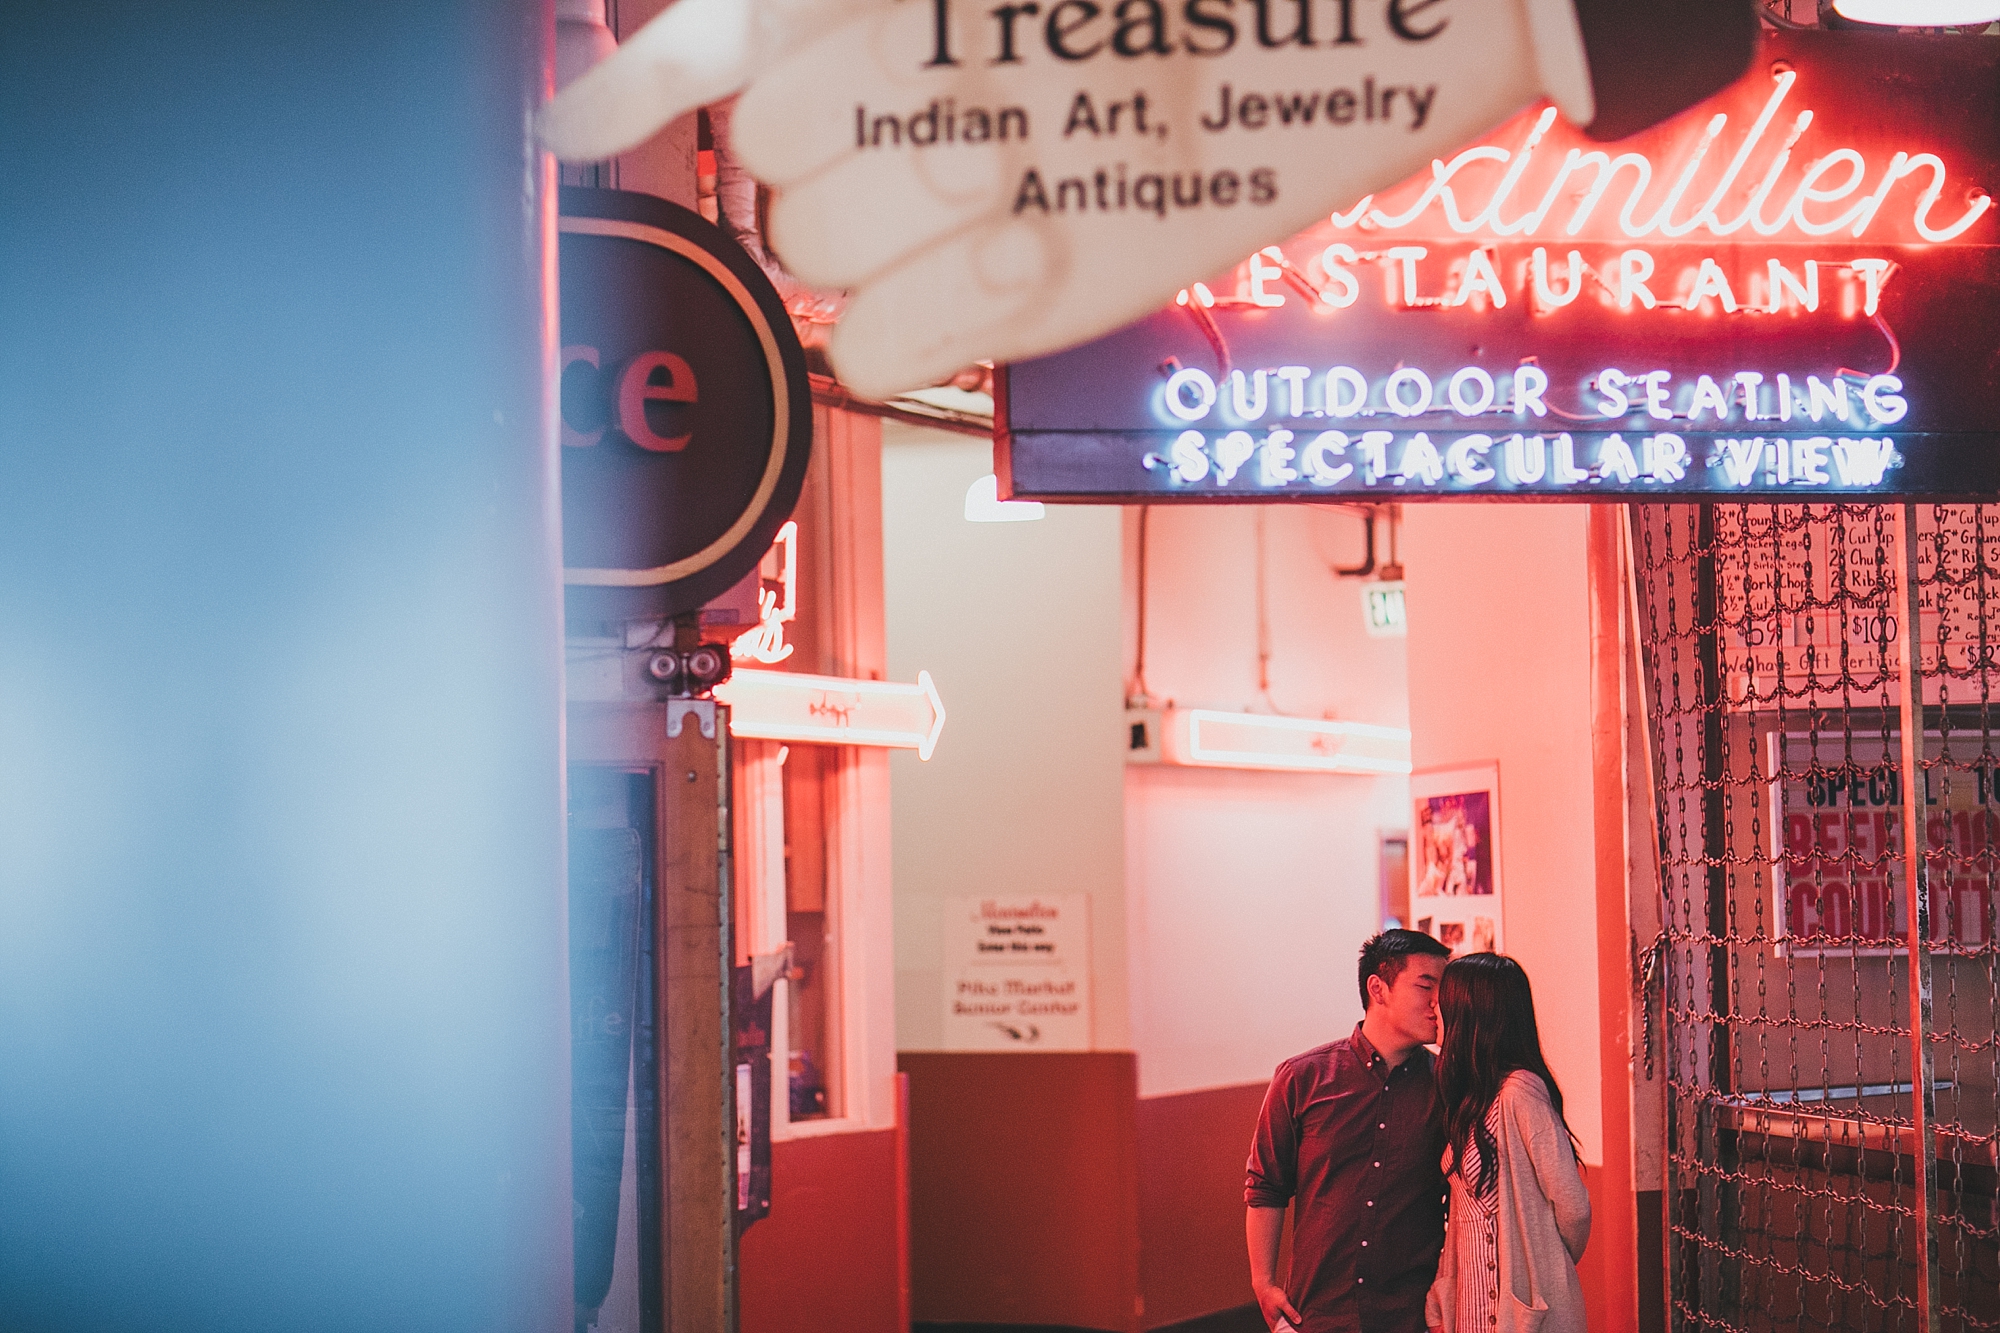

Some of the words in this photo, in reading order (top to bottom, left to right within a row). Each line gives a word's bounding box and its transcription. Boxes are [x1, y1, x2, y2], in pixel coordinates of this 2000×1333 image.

[855, 103, 1029, 148] Indian
[1062, 90, 1169, 138] Art,
[1202, 76, 1439, 132] Jewelry
[1011, 161, 1279, 219] Antiques
[1175, 244, 1889, 317] ESTAURANT
[1165, 365, 1549, 421] OUTDOOR
[1597, 367, 1908, 425] SEATING
[1168, 428, 1688, 484] SPECTACULAR
[1722, 436, 1895, 487] VIEW
[1806, 765, 1938, 806] SPECIL
